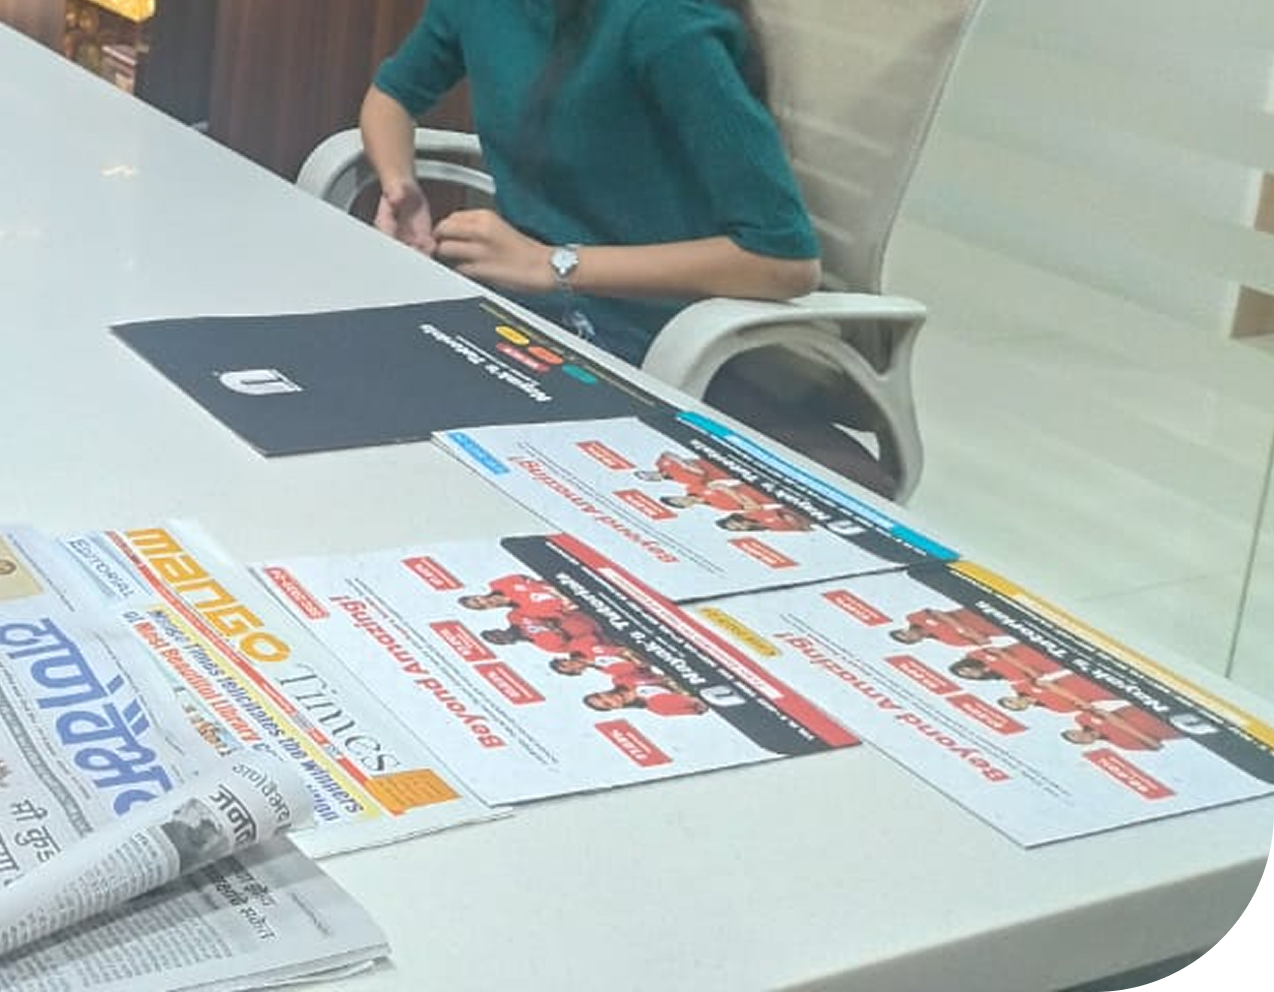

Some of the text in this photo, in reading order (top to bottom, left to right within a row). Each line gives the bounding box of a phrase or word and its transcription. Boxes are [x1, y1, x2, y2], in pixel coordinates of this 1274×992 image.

[593, 515, 680, 563] Beyond
[328, 594, 430, 676] Amazing!
[555, 572, 629, 630] Tutorials
[133, 620, 170, 654] Most
[161, 648, 224, 701] Beautiful
[211, 695, 262, 743] Library
[629, 630, 707, 686] Nayak's
[772, 631, 901, 718] Amazing!
[974, 599, 1169, 714] Nayak's Tutorials
[277, 663, 400, 772] Times
[414, 677, 506, 748] Beyond
[894, 711, 1012, 784] Beyond
[278, 732, 308, 761] the
[301, 756, 364, 814] winners
